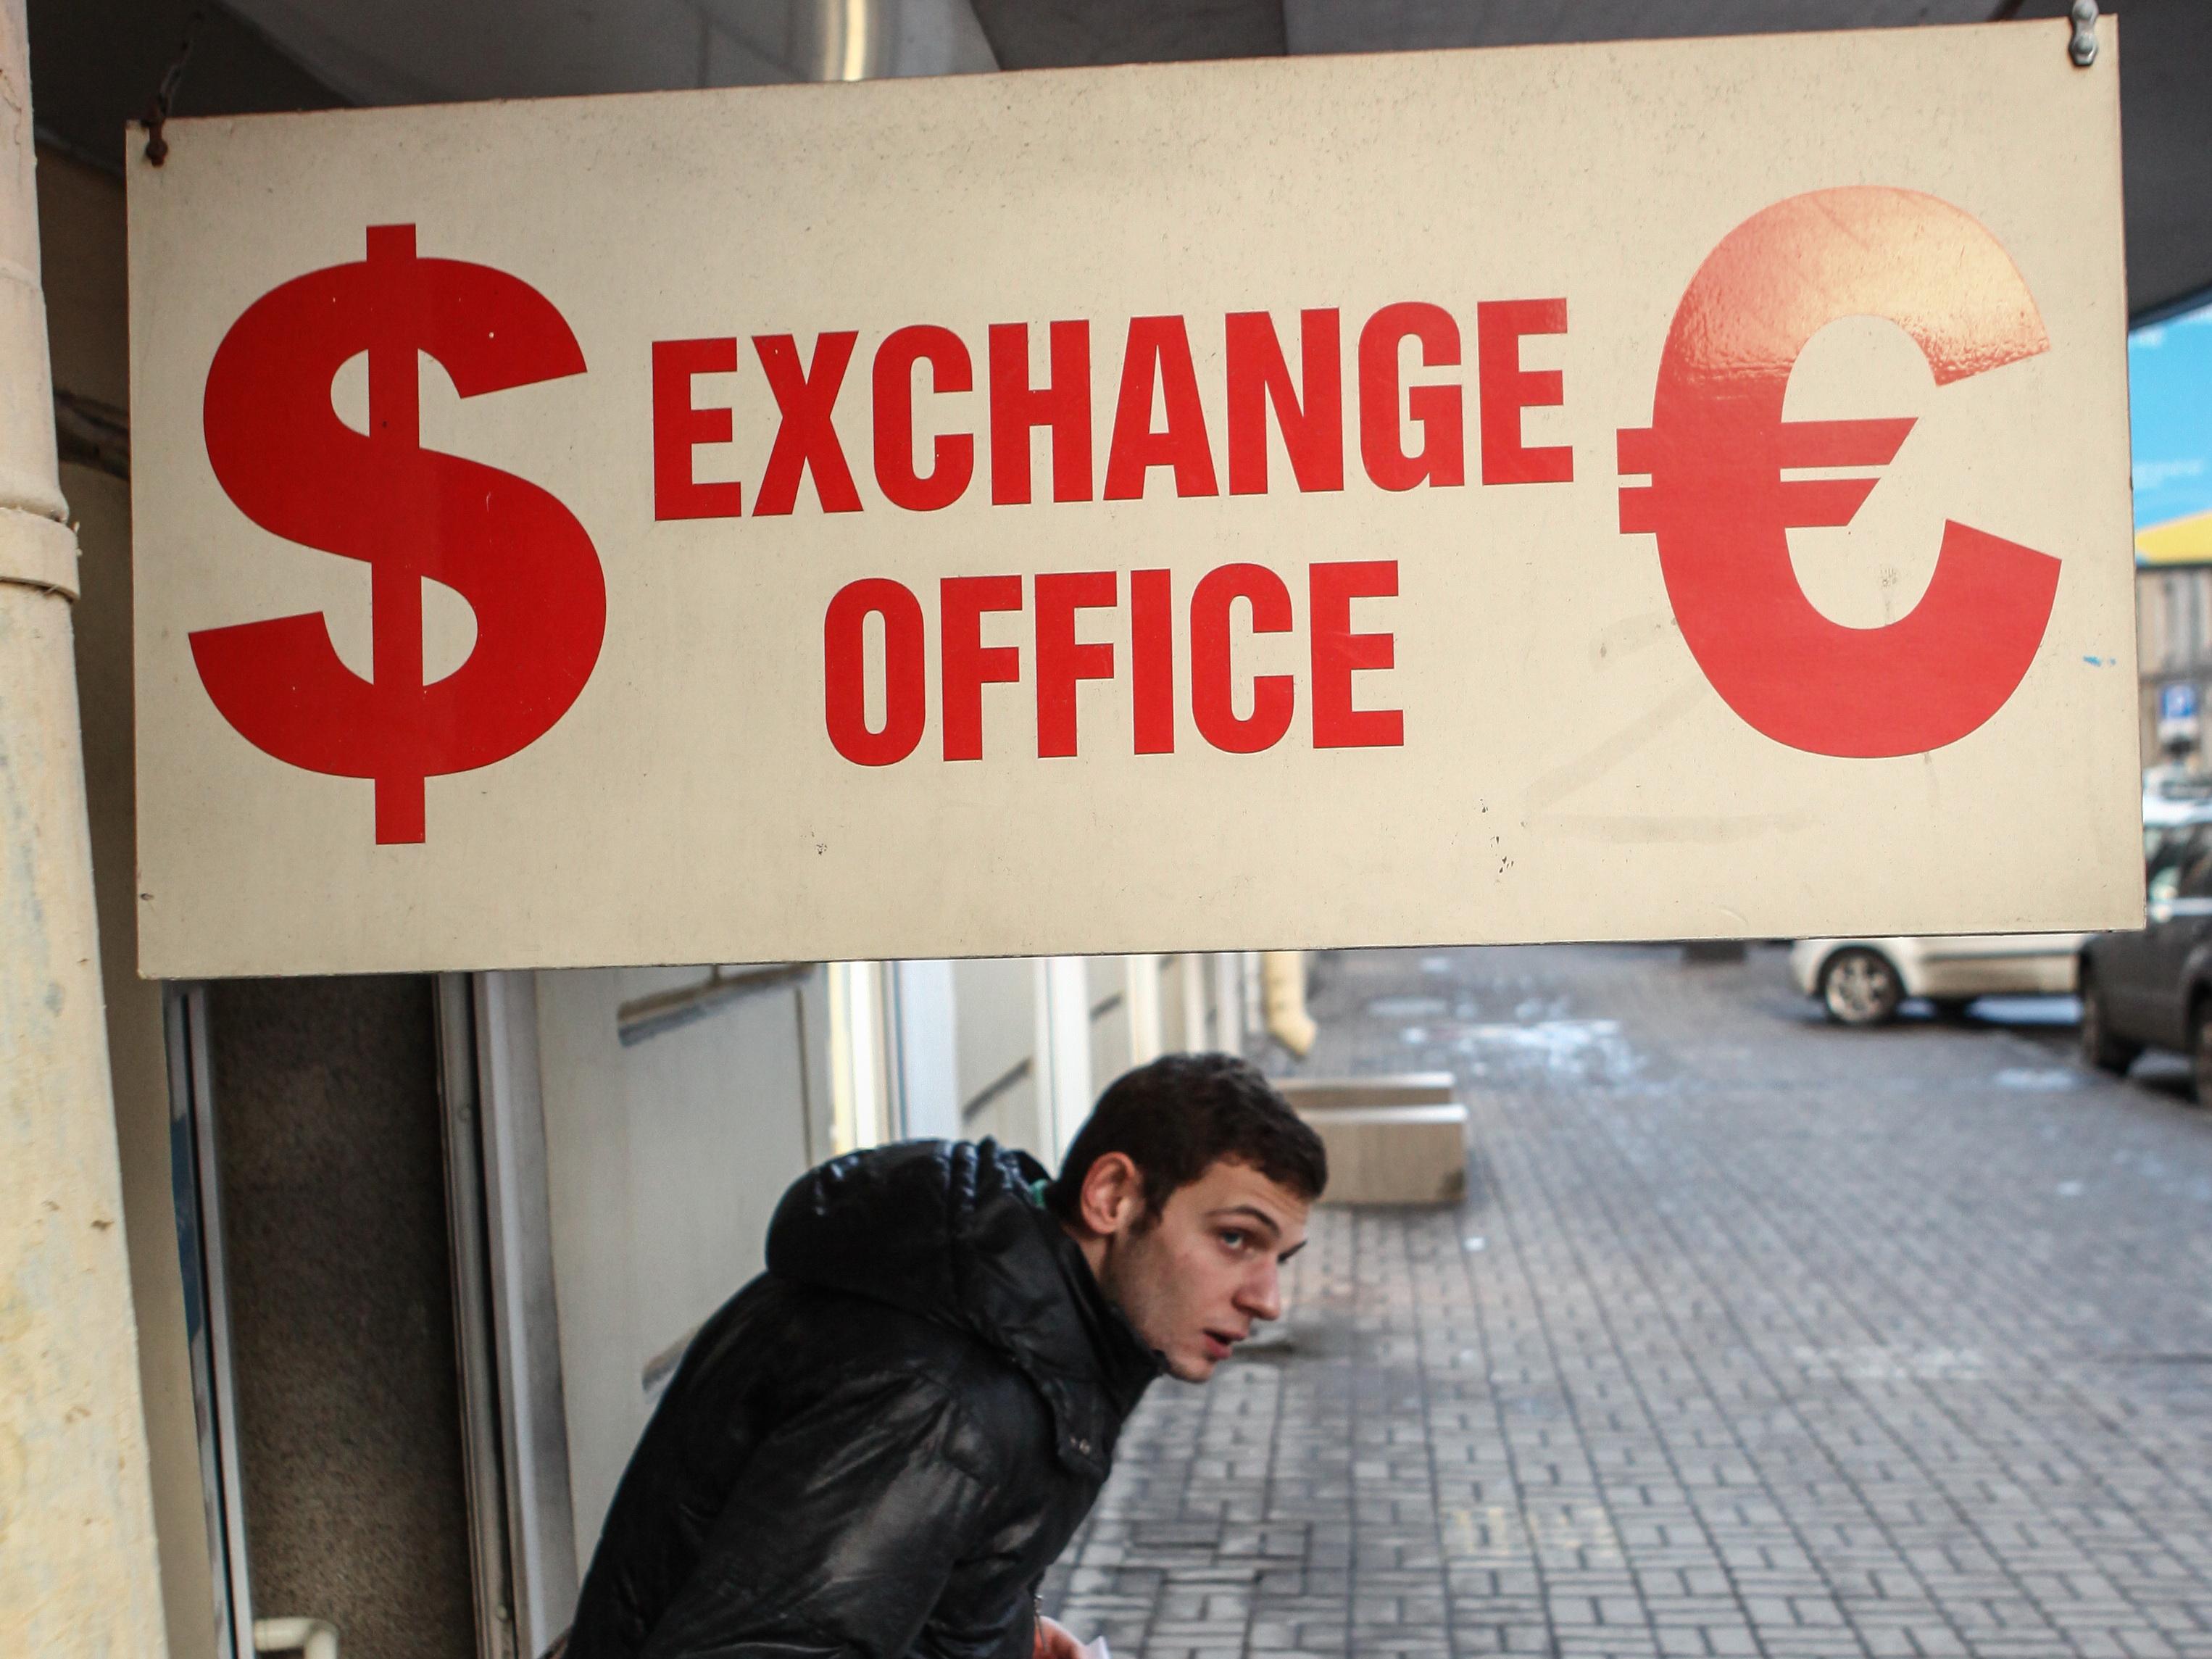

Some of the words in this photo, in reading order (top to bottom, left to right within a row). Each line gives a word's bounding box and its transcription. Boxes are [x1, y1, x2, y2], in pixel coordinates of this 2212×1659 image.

[652, 297, 1574, 521] EXCHANGE
[190, 223, 607, 845] $
[823, 560, 1405, 767] OFFICE
